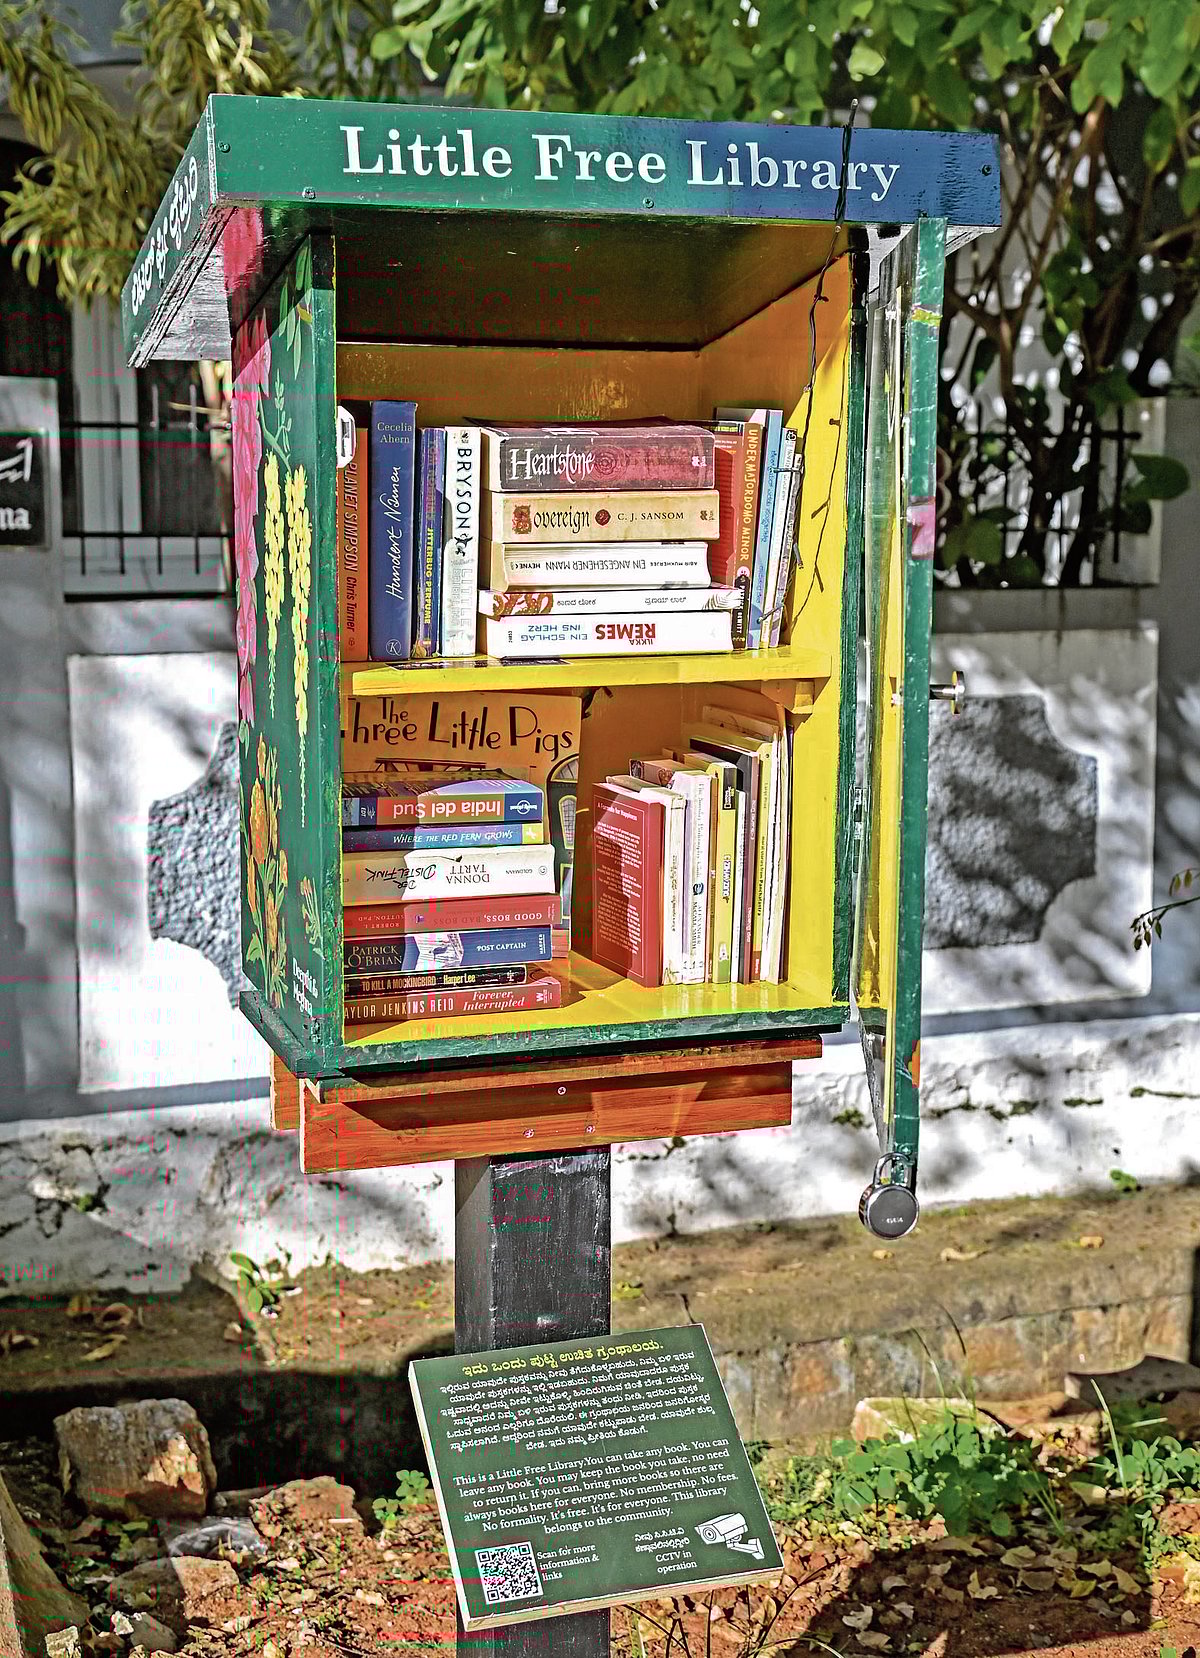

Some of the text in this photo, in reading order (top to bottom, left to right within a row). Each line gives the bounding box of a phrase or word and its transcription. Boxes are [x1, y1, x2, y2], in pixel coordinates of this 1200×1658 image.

[340, 125, 900, 202] Little Free Library
[377, 422, 412, 444] Cecelia Ahern
[509, 444, 596, 484] Heartstone
[456, 448, 473, 529] BRYSON
[740, 430, 758, 560] UNDERMAJORDOMO MINOR
[344, 463, 358, 572] PLANET SIMPSON
[618, 512, 684, 522] C. J. SANSOM
[380, 466, 403, 600] Hundert Namen
[425, 527, 433, 578] JITTERBUG
[545, 560, 646, 571] EIN ANGESEHENER MANN
[346, 576, 357, 632] Chris Turner
[424, 580, 432, 624] PERFUME
[595, 624, 656, 639] REMES
[376, 697, 408, 724] The
[428, 702, 500, 750] Little
[509, 706, 572, 761] Pigs
[393, 800, 500, 818] India del Sud
[441, 834, 458, 842] RED
[460, 832, 482, 842] FERN
[484, 830, 513, 840] GROWS
[446, 865, 490, 884] DONNA TARTT
[393, 880, 417, 890] DER
[433, 917, 458, 925] BOSS
[460, 915, 481, 924] BAD
[483, 914, 510, 924] BOSS,
[514, 912, 542, 920] GOOD
[352, 946, 398, 956] PATRICK
[498, 942, 527, 950] CAPTAIN
[348, 954, 402, 968] O'BRIAN
[362, 975, 437, 991] TO KILL A MOCKINGBIRD
[463, 998, 525, 1011] Interrupted
[472, 990, 514, 1001] Forever,
[344, 998, 454, 1019] AYLOR JENKINS REID
[461, 1339, 663, 1377] ಇದು ಒಂದು ಪುಟ್ಟ ಉಚಿತ ಗ್ರಂಥಾಲಯ.
[452, 1474, 476, 1485] This
[477, 1473, 486, 1482] is
[495, 1467, 522, 1479] Little
[523, 1465, 546, 1475] Free
[605, 1454, 622, 1462] can
[623, 1449, 644, 1459] take
[645, 1448, 662, 1457] any
[663, 1442, 691, 1453] book.
[690, 1440, 711, 1449] You
[712, 1438, 729, 1446] can
[458, 1487, 485, 1497] leave
[486, 1483, 505, 1493] any
[505, 1477, 534, 1489] book.
[535, 1475, 556, 1485] You
[556, 1472, 578, 1482] may
[579, 1469, 603, 1478] keep
[604, 1465, 620, 1474] the
[621, 1460, 647, 1471] book
[647, 1459, 667, 1470] you
[667, 1455, 690, 1465] take,
[706, 1447, 730, 1459] need
[485, 1492, 517, 1505] return
[518, 1491, 529, 1500] it.
[530, 1488, 539, 1498] If
[540, 1487, 561, 1498] you
[562, 1484, 582, 1493] can,
[582, 1479, 610, 1490] bring
[611, 1473, 638, 1486] more
[638, 1470, 668, 1481] books
[681, 1465, 707, 1475] there
[708, 1463, 724, 1471] are
[463, 1472, 738, 1522] always books here for everyone. No membership. No fees.
[482, 1486, 727, 1531] No formality. It's free. It's for everyone. This library
[543, 1521, 582, 1534] belongs
[596, 1515, 613, 1525] the
[614, 1506, 673, 1522] community.
[536, 1544, 596, 1559] Scan for more
[655, 1550, 692, 1562] CCTV in
[539, 1553, 599, 1570] information &
[656, 1560, 697, 1574] operation
[541, 1571, 562, 1581] links
